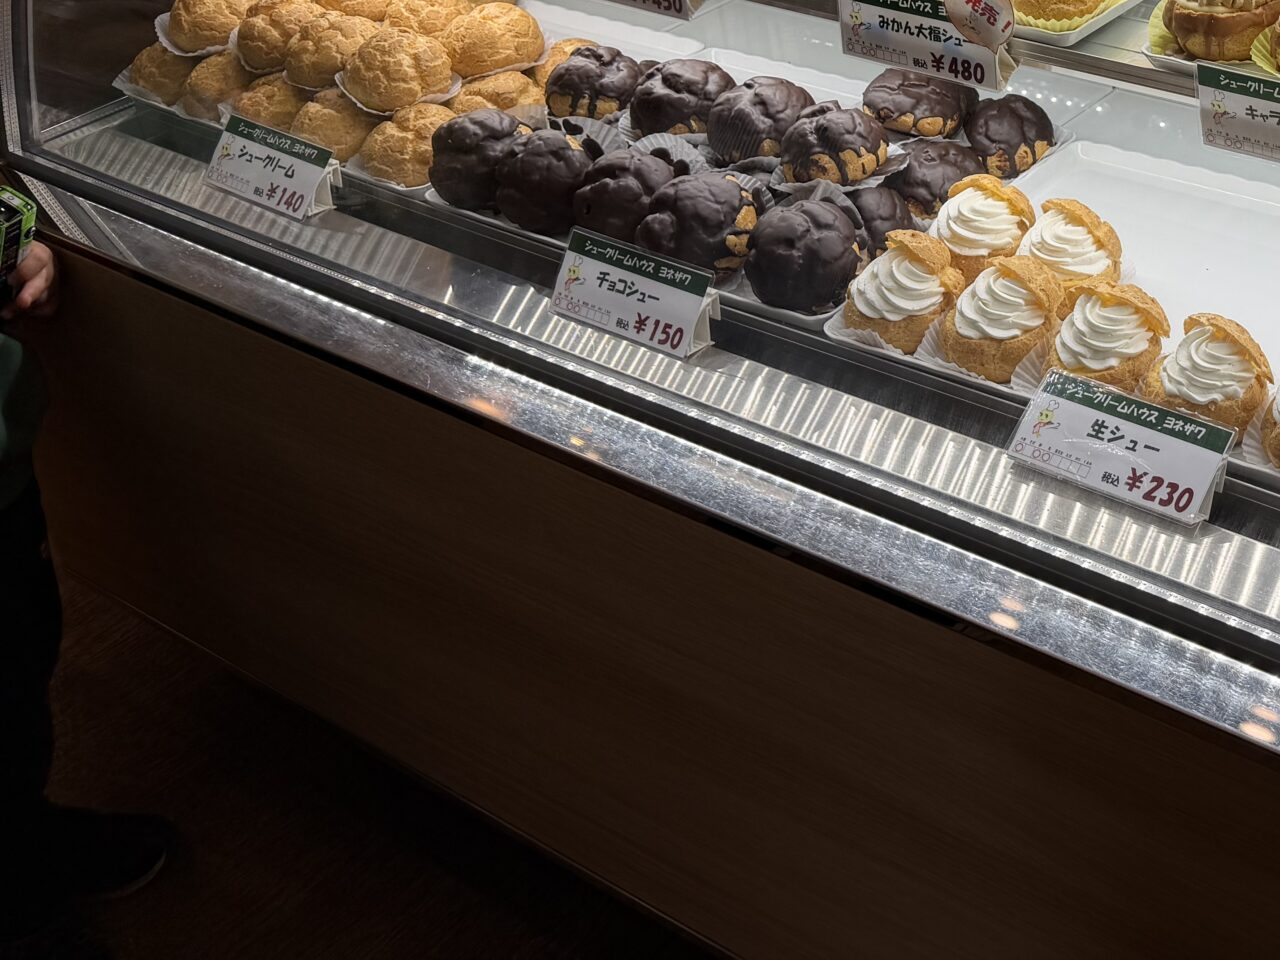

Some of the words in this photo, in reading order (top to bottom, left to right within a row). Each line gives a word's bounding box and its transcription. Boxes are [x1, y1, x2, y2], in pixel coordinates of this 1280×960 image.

[878, 14, 973, 47] みかん大福シュー
[912, 57, 928, 70] 税込
[930, 51, 985, 85] ¥480
[238, 122, 292, 150] シュークリームハウス
[294, 143, 318, 160] ヨネザワ
[238, 144, 296, 179] シュークリーム
[265, 182, 305, 214] ¥140
[584, 240, 655, 273] シュークリームハウス
[658, 266, 692, 286] ヨネザワ
[596, 270, 660, 304] チョコシュー
[616, 316, 630, 332] 税込
[632, 312, 684, 350] ¥150
[1065, 383, 1160, 424] シュークリームハウス
[1162, 416, 1208, 440] ヨネザワ
[1086, 418, 1161, 454] 生シュー
[1101, 470, 1120, 488] 税込
[1124, 466, 1194, 513] ¥230
